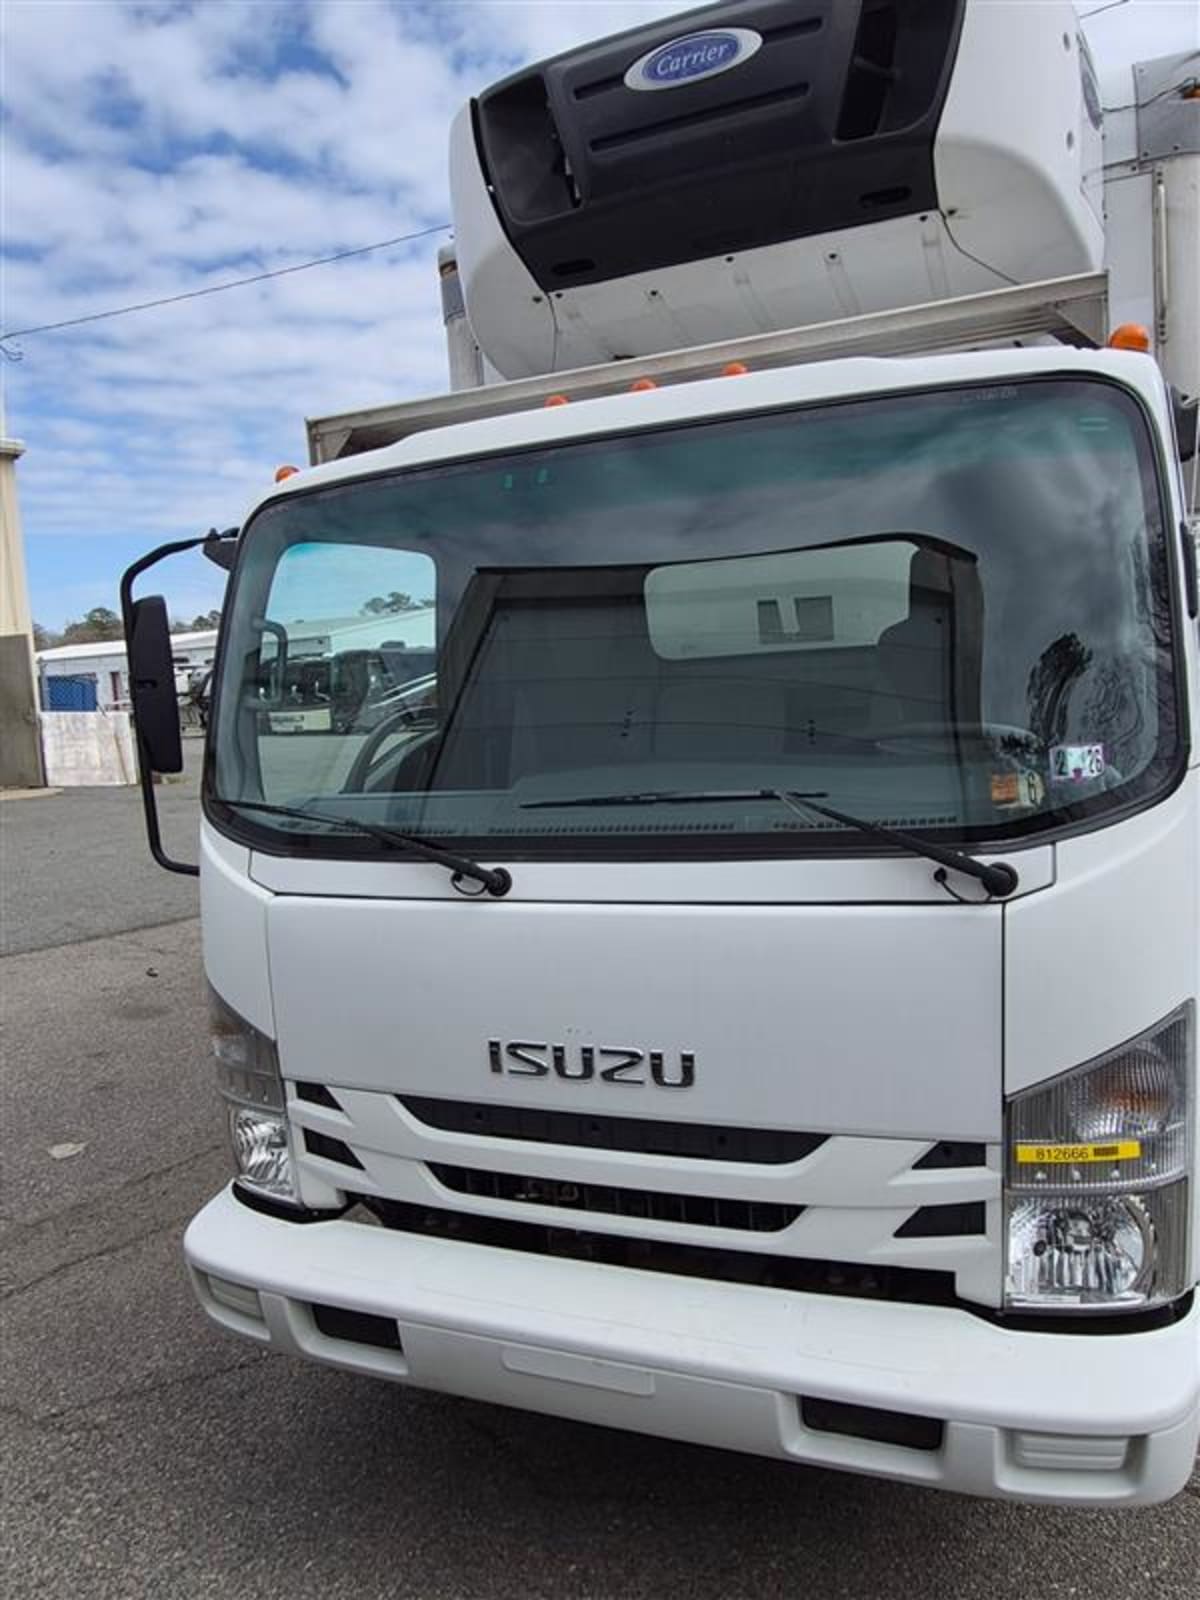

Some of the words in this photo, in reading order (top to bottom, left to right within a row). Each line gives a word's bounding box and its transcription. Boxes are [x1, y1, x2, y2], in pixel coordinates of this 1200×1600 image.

[656, 42, 729, 77] Carrier
[488, 1037, 696, 1089] ISUZU
[1035, 1146, 1089, 1161] 812666
